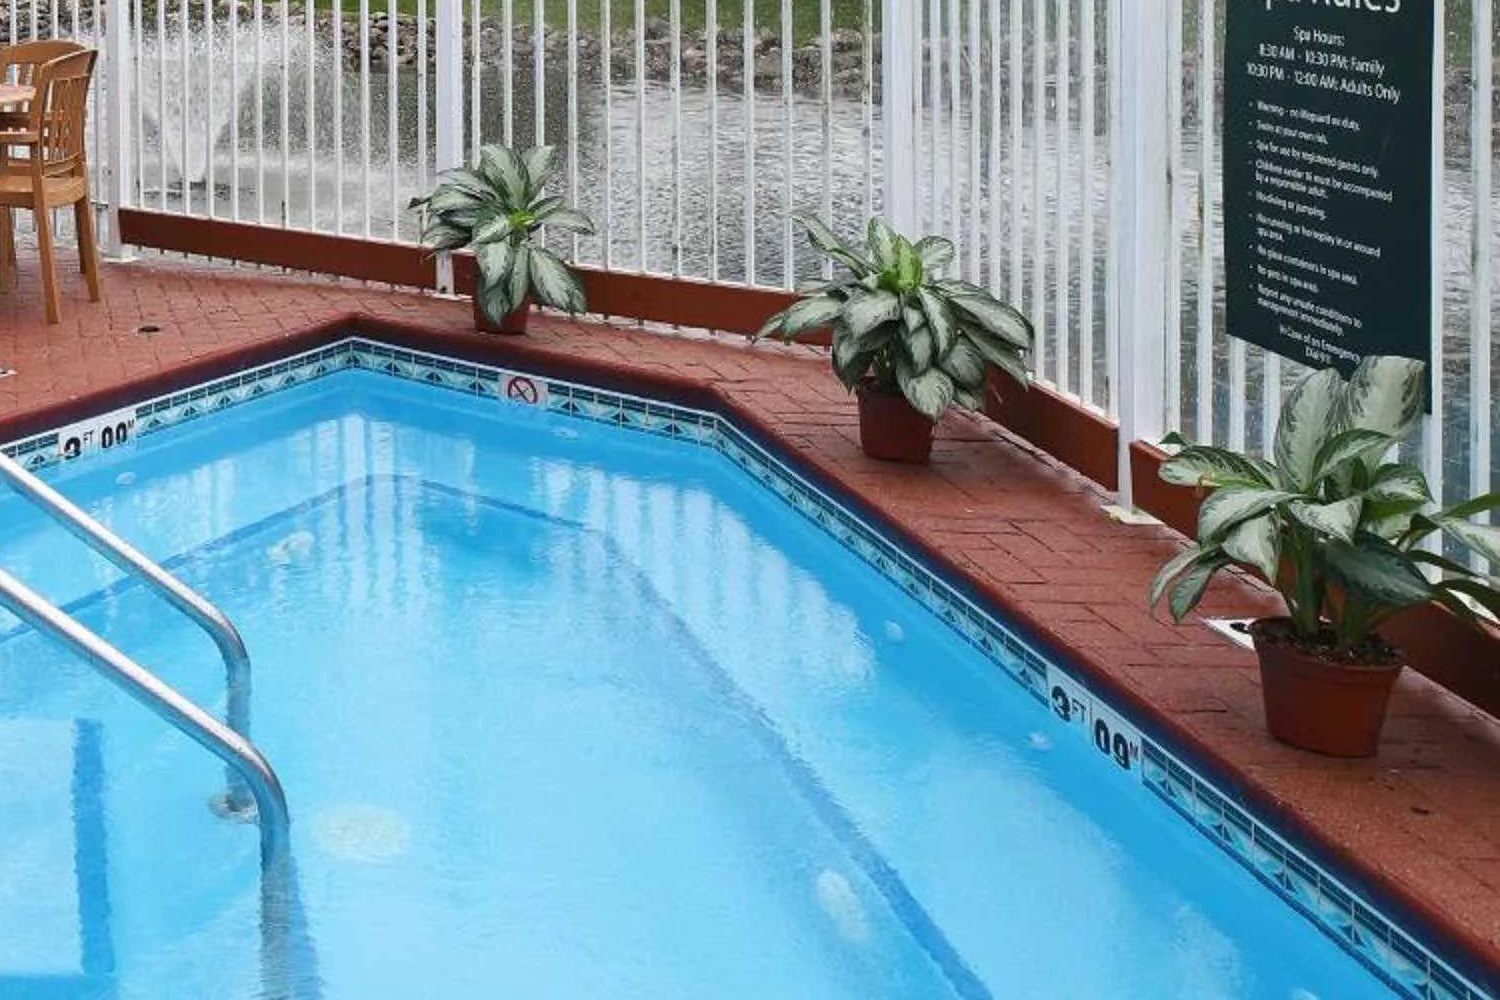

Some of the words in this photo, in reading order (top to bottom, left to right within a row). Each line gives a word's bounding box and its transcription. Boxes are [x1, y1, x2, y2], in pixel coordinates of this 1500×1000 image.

[1293, 25, 1311, 43] Spa
[1313, 28, 1345, 46] Hours:
[1279, 45, 1295, 61] AM
[1351, 57, 1385, 79] Family
[1269, 65, 1285, 81] PM
[1340, 77, 1373, 97] Adults
[1375, 83, 1400, 105] Only
